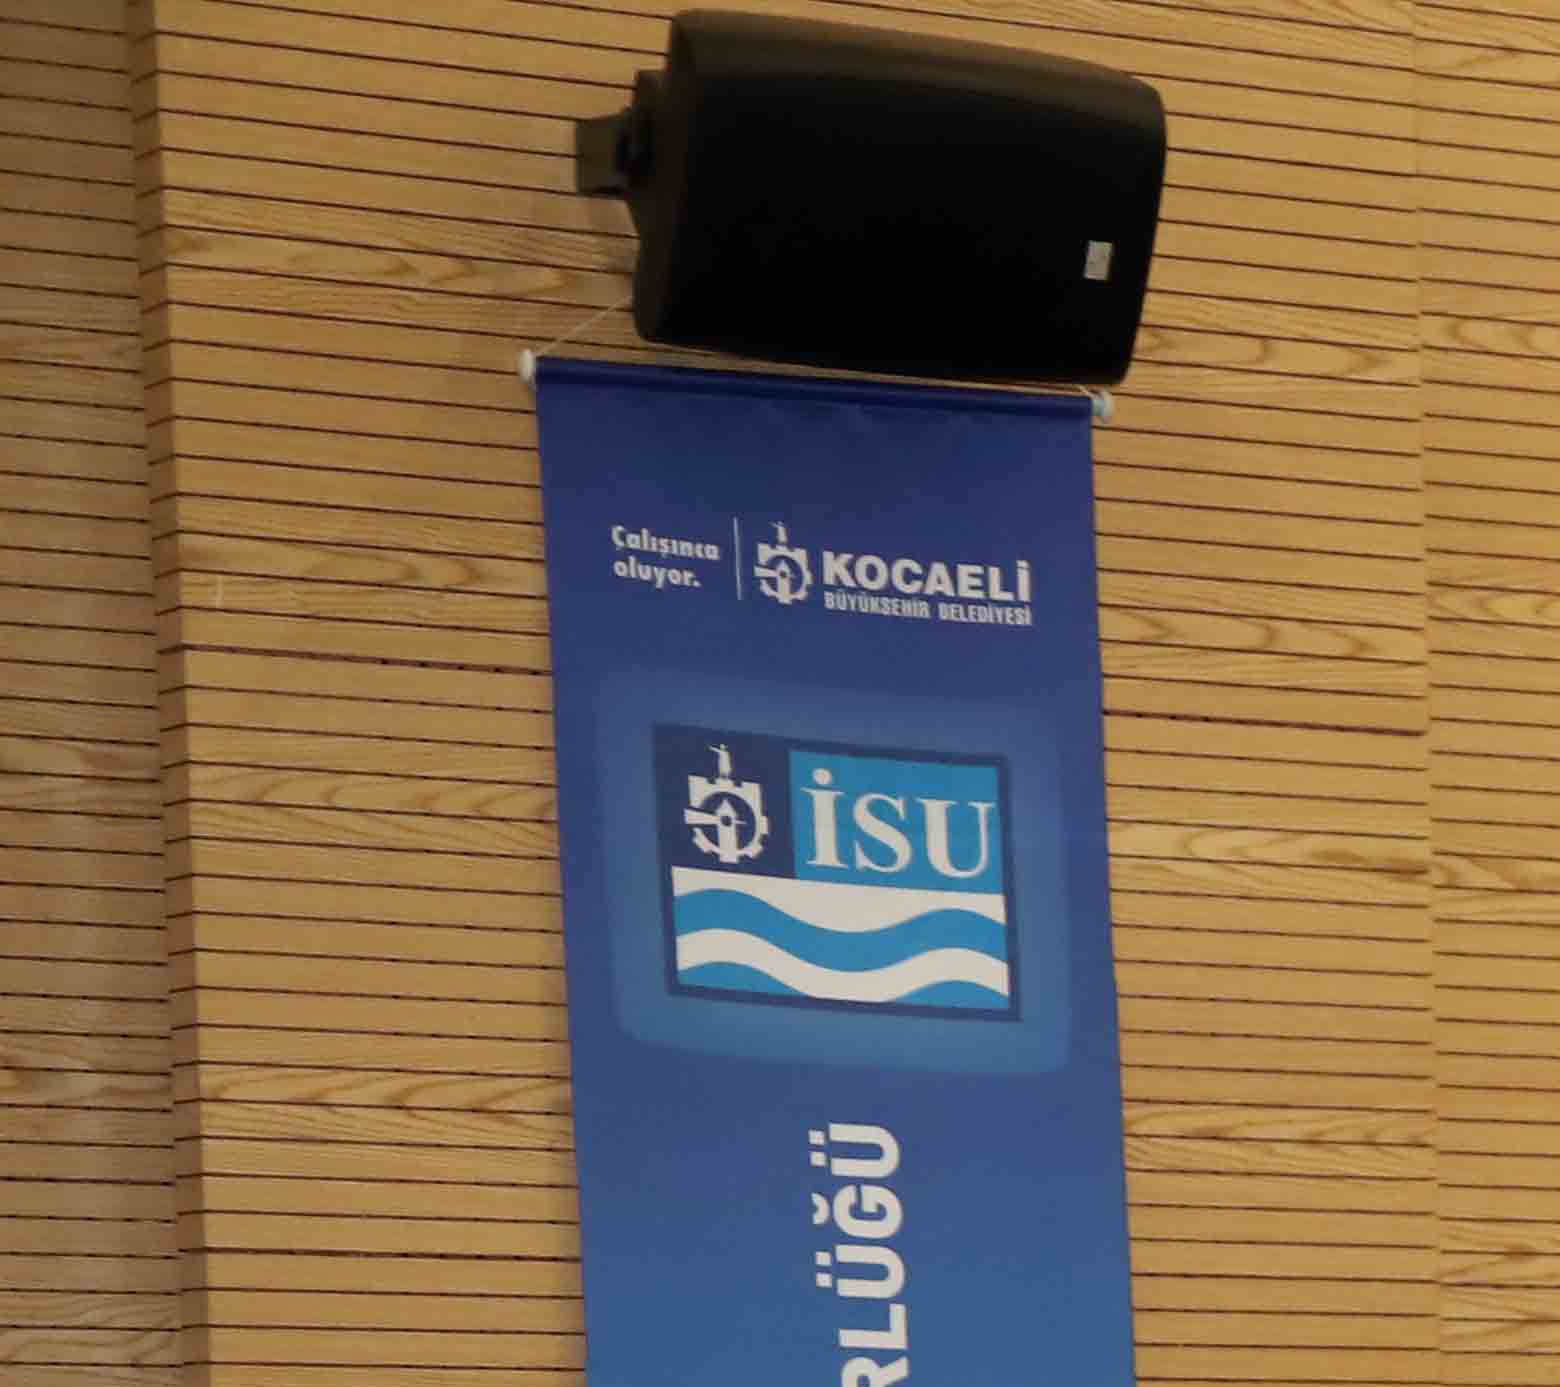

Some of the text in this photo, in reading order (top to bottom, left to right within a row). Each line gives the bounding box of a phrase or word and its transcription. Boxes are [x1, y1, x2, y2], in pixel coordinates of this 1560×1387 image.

[613, 556, 702, 589] oluyor.
[822, 549, 1032, 602] KOCAELİ
[801, 767, 995, 880] İSU
